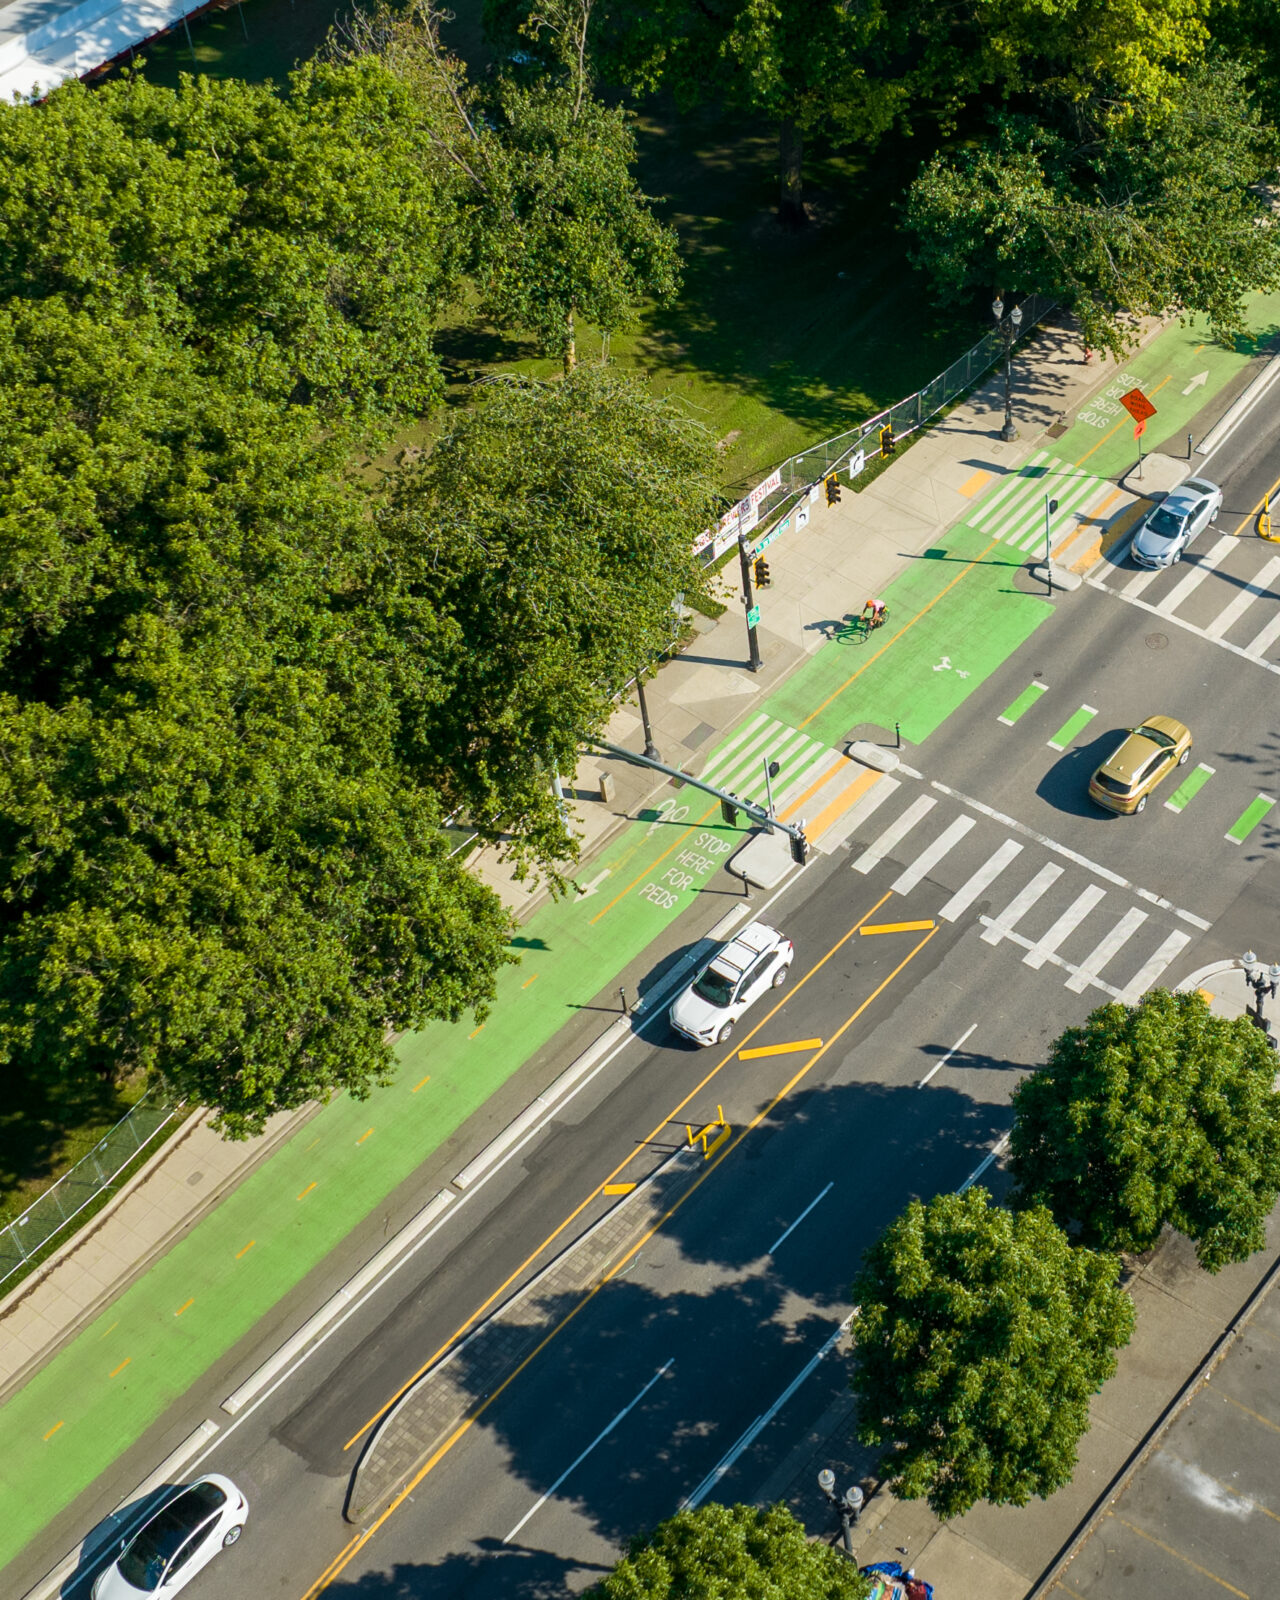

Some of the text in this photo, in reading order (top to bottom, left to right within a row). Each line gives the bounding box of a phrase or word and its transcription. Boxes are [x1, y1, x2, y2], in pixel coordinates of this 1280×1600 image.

[1089, 397, 1123, 416] HERE
[1077, 411, 1109, 428] STOP
[751, 475, 780, 504] FESTIVAL
[694, 832, 731, 855] STOP
[675, 848, 715, 875] HERE
[661, 867, 694, 891] FOR
[638, 882, 678, 909] PEDS
